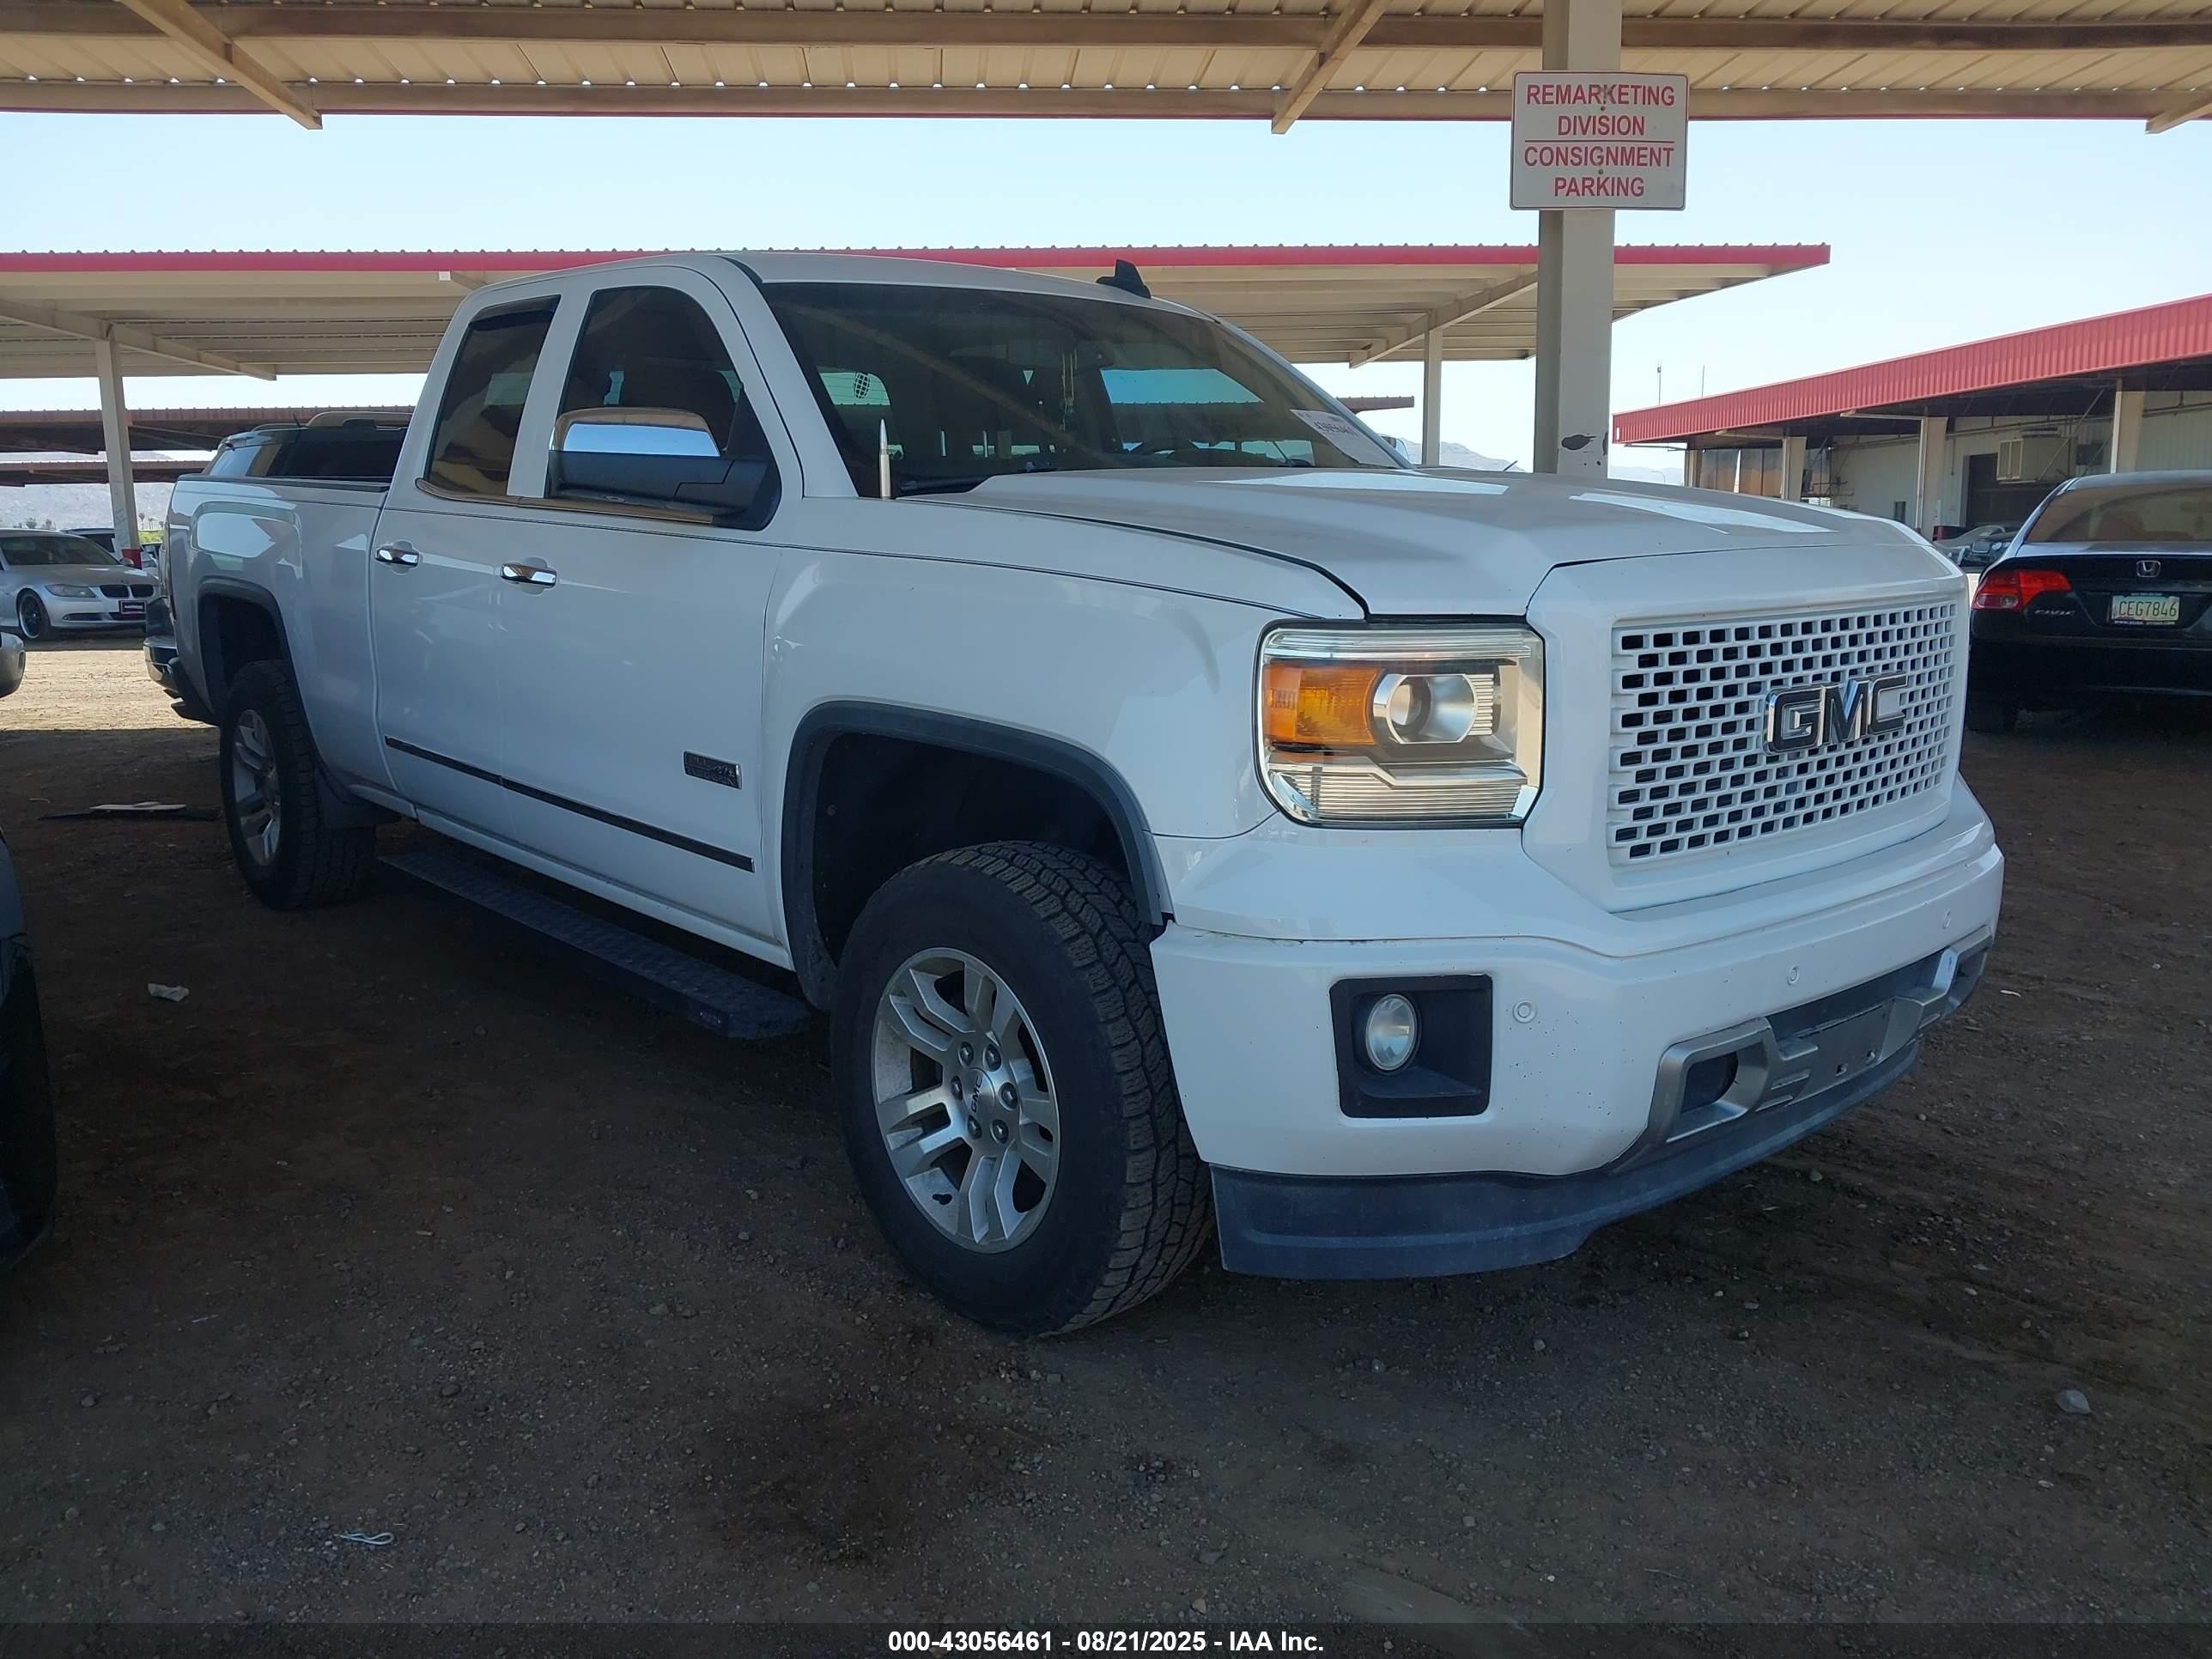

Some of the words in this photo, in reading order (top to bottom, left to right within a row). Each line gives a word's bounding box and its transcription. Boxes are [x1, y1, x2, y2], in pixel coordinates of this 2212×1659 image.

[1527, 84, 1674, 106] REMARKETING
[1558, 115, 1645, 136] DIVISION
[1524, 146, 1674, 167] CONSIGNMENT
[1554, 177, 1644, 197] PARKING
[2118, 601, 2177, 617] CEG7846
[1765, 672, 1908, 754] GMC
[971, 1075, 983, 1112] GMC
